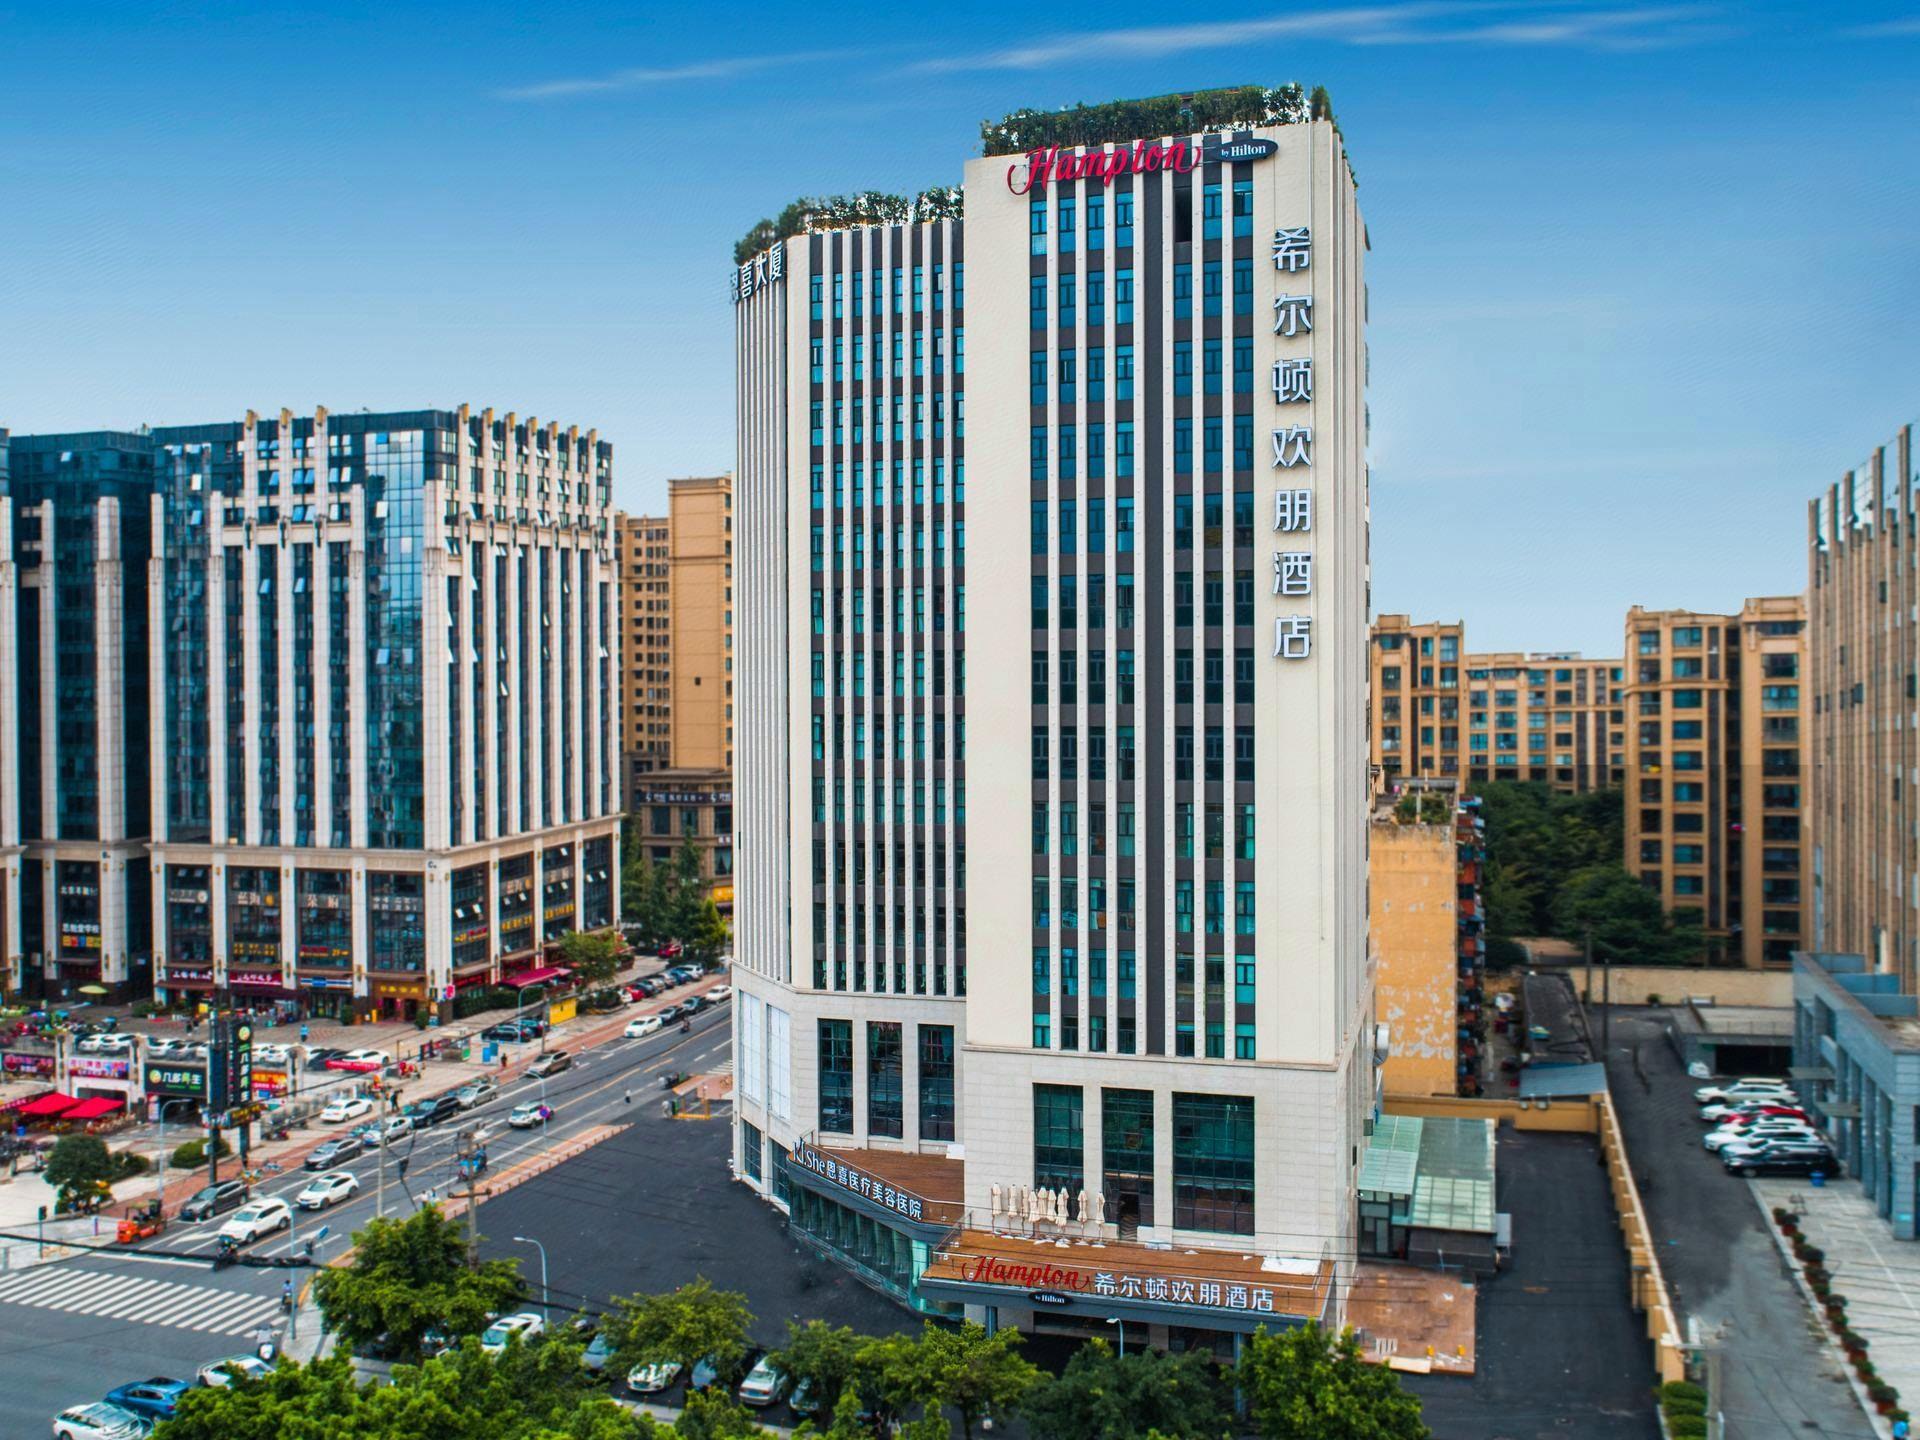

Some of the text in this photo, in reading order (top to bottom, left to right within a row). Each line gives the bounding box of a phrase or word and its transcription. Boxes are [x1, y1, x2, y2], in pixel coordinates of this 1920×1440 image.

[1007, 139, 1267, 195] Hampton by Hilton
[732, 240, 783, 299] 喜大厦
[1271, 226, 1313, 660] 希尔顿欢朋酒店
[827, 1160, 923, 1221] 恩喜医疗美容医院
[962, 1255, 1275, 1312] Hampton 希尔顿欢朋酒店
[1041, 1294, 1065, 1304] Hilton
